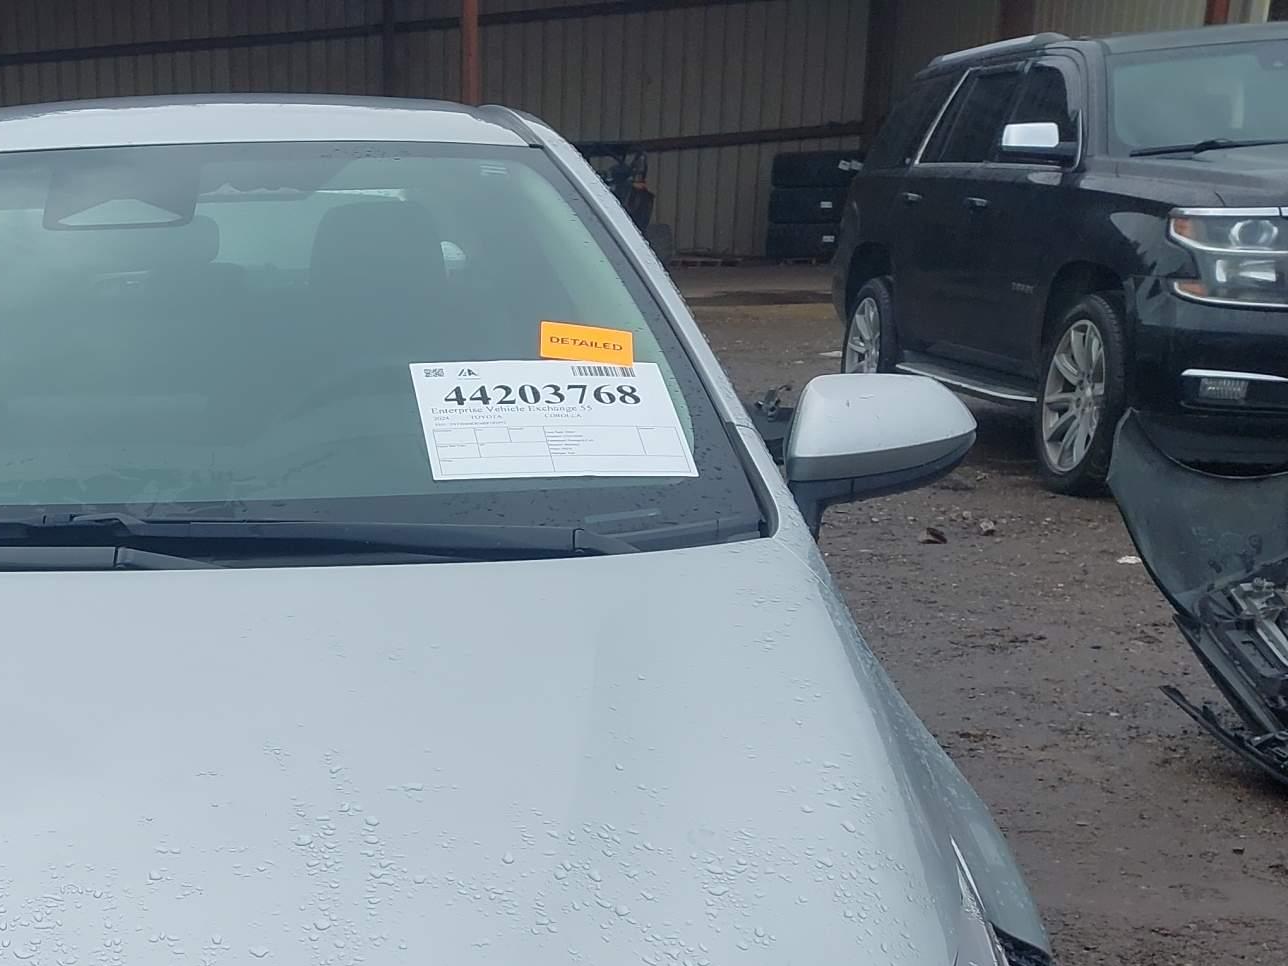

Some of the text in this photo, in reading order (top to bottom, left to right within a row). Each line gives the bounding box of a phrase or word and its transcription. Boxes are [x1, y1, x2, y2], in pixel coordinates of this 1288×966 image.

[549, 336, 623, 351] DETAILED
[444, 383, 641, 406] 44203768
[431, 407, 484, 415] Enterprise
[485, 405, 525, 413] Vehicle
[527, 405, 577, 413] Exchange
